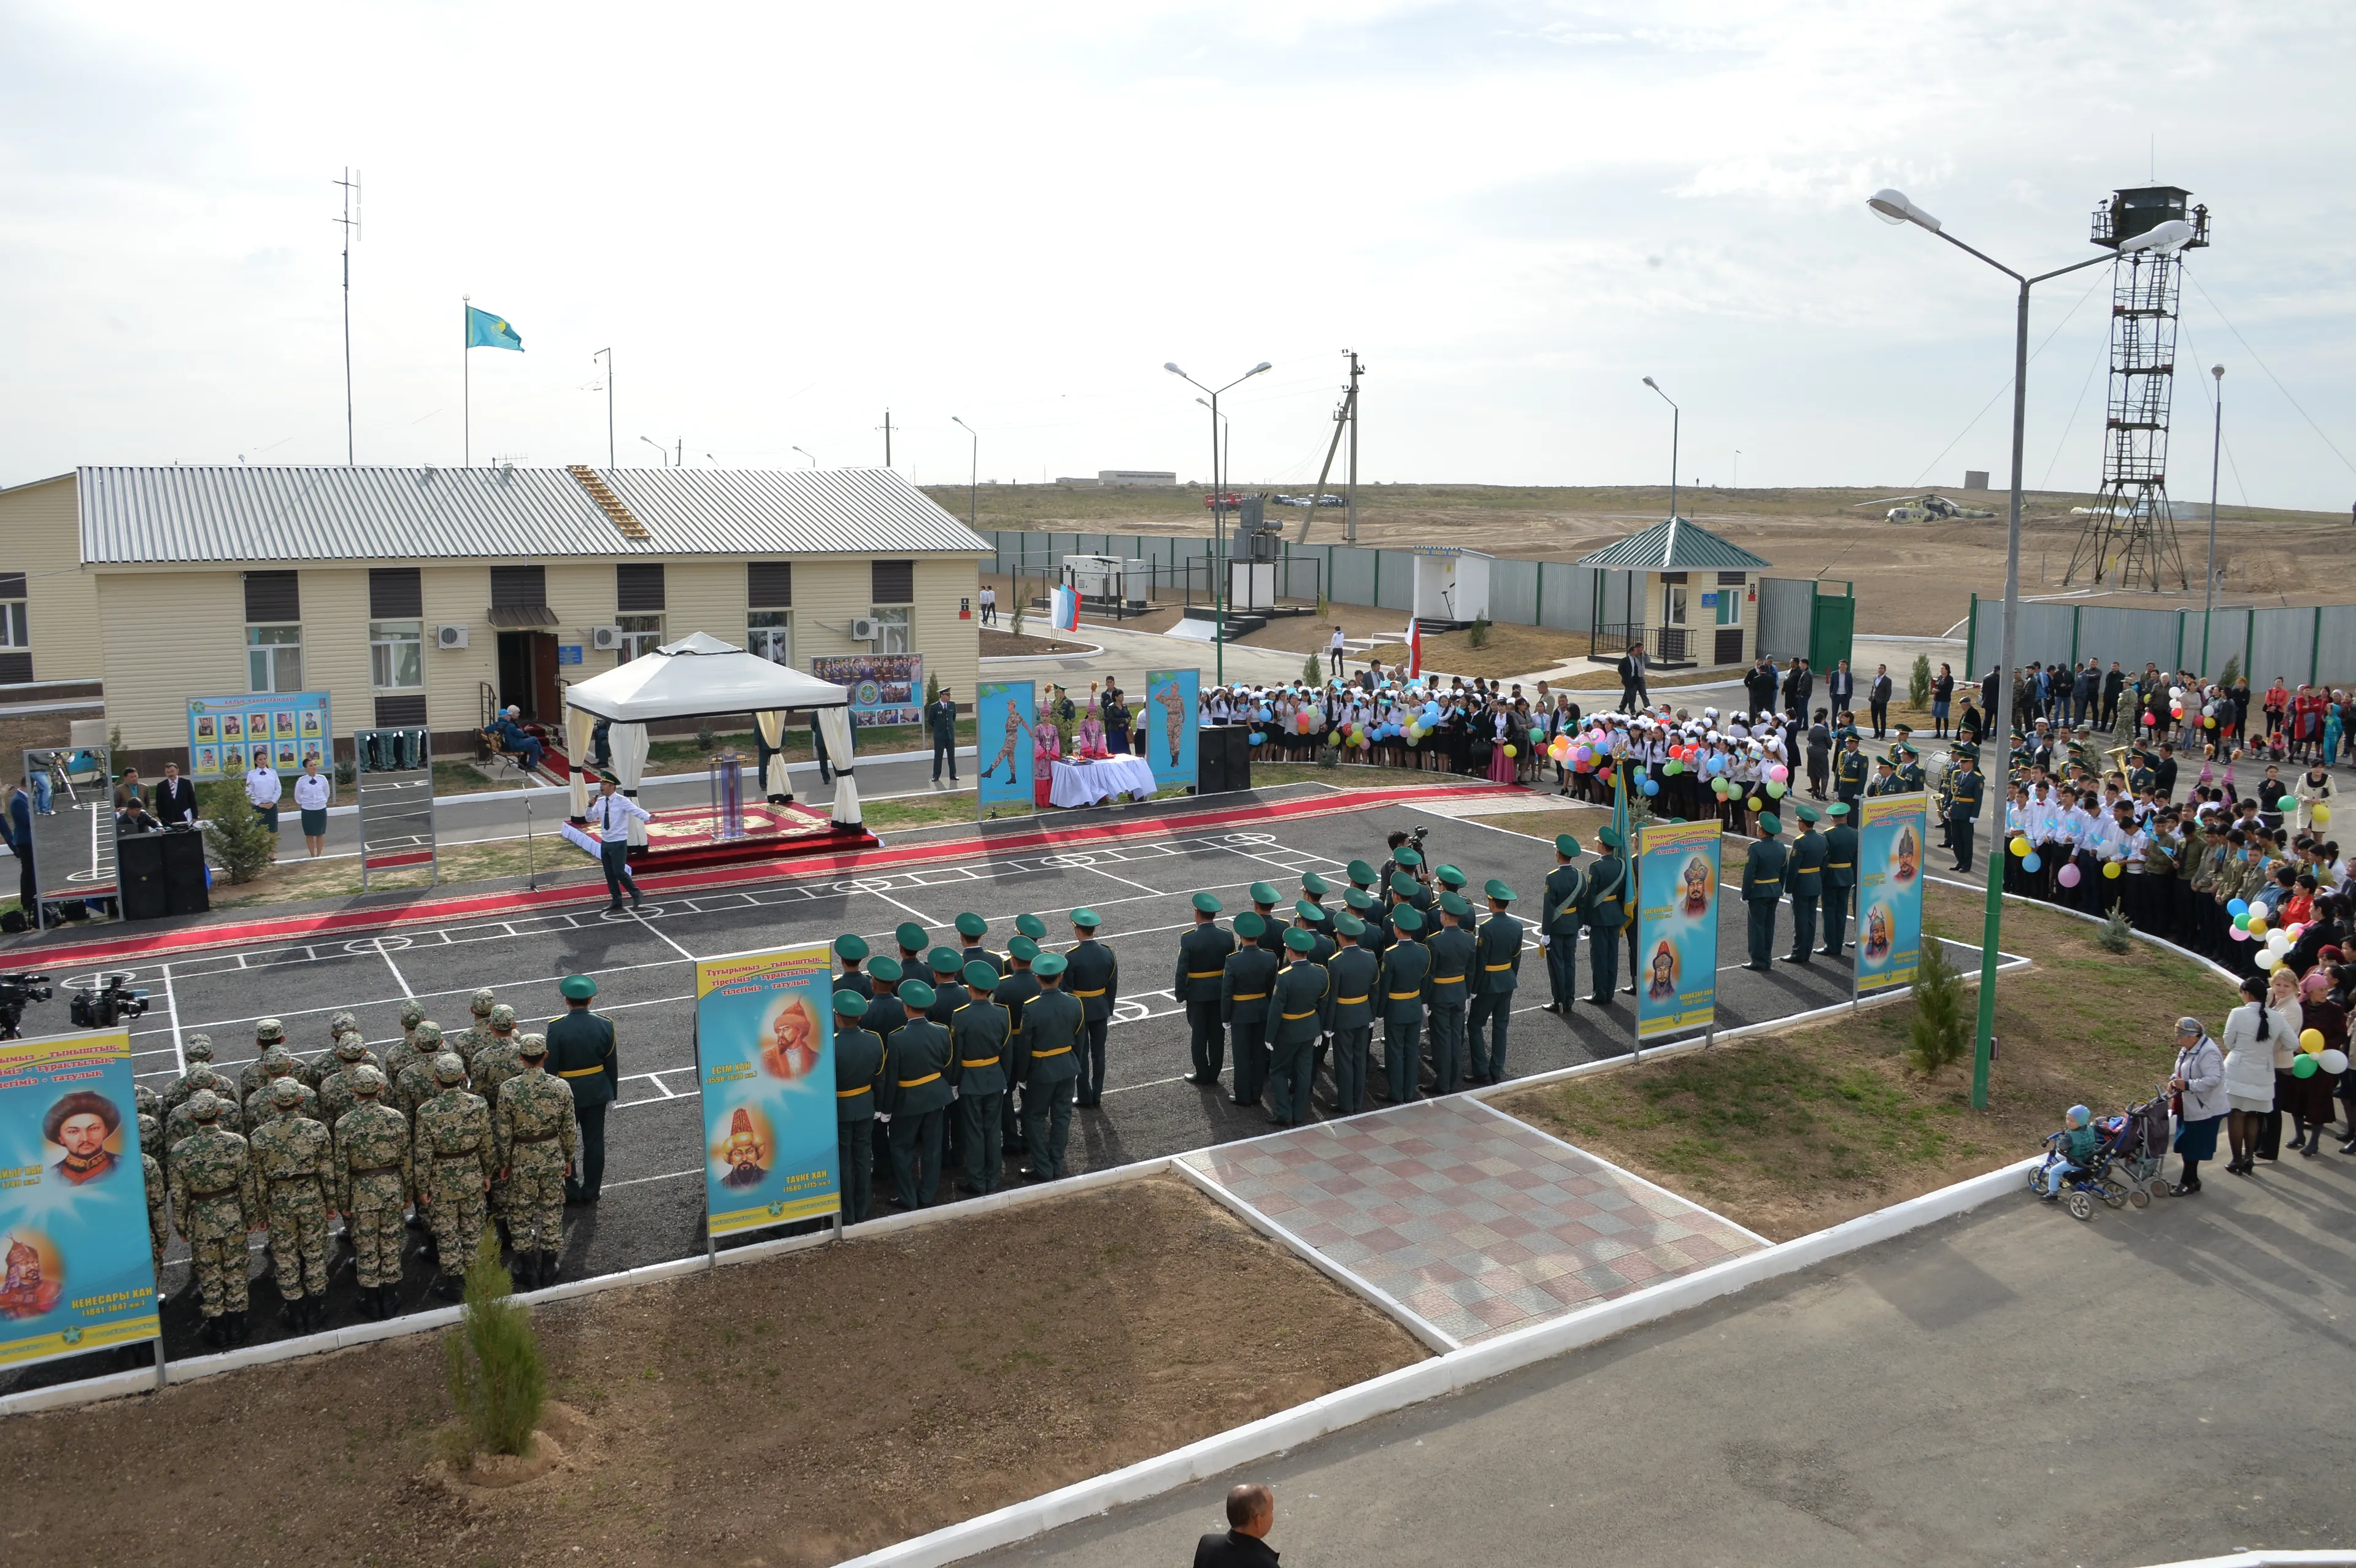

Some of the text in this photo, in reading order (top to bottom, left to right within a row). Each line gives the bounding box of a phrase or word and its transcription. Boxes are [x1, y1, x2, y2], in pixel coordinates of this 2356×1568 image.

[706, 965, 760, 977] Тұғырымыз
[711, 976, 751, 986] тірегіміз
[722, 985, 761, 996] тілегіміз
[811, 1169, 827, 1180] ХАН
[71, 1286, 153, 1309] КЕНЕСАРЫ ХАН
